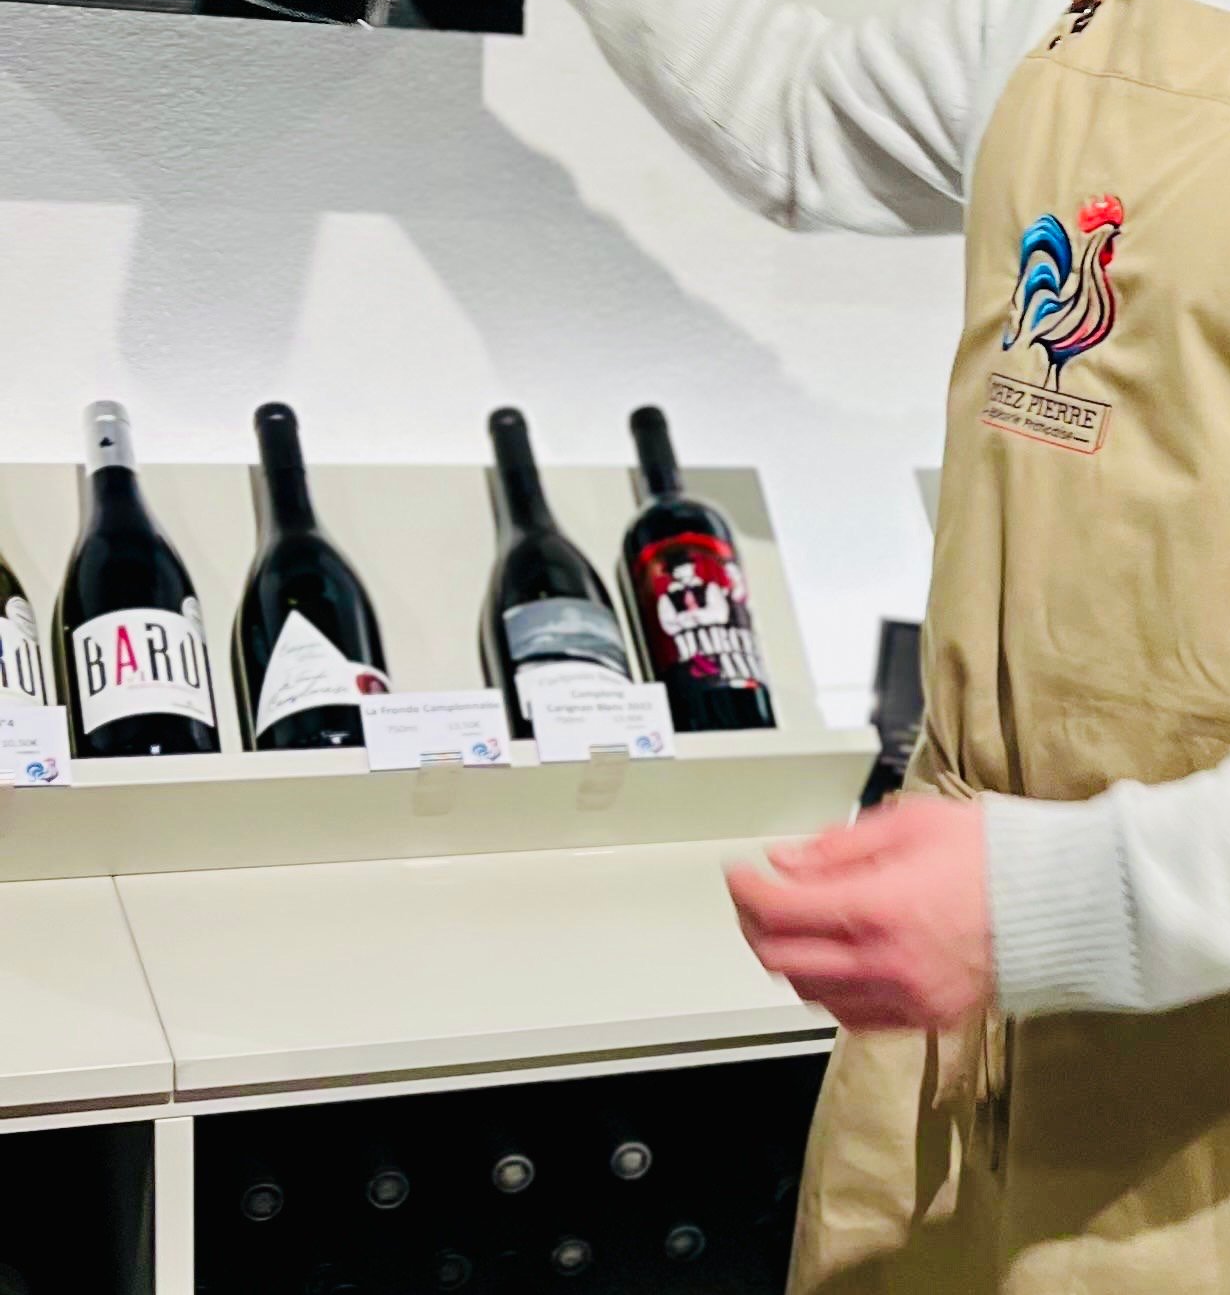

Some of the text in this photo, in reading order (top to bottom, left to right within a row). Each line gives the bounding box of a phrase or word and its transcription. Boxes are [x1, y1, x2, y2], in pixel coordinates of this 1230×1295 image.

[990, 382, 1026, 409] HEZ
[1027, 393, 1097, 429] PIERRE
[83, 622, 201, 697] BARO
